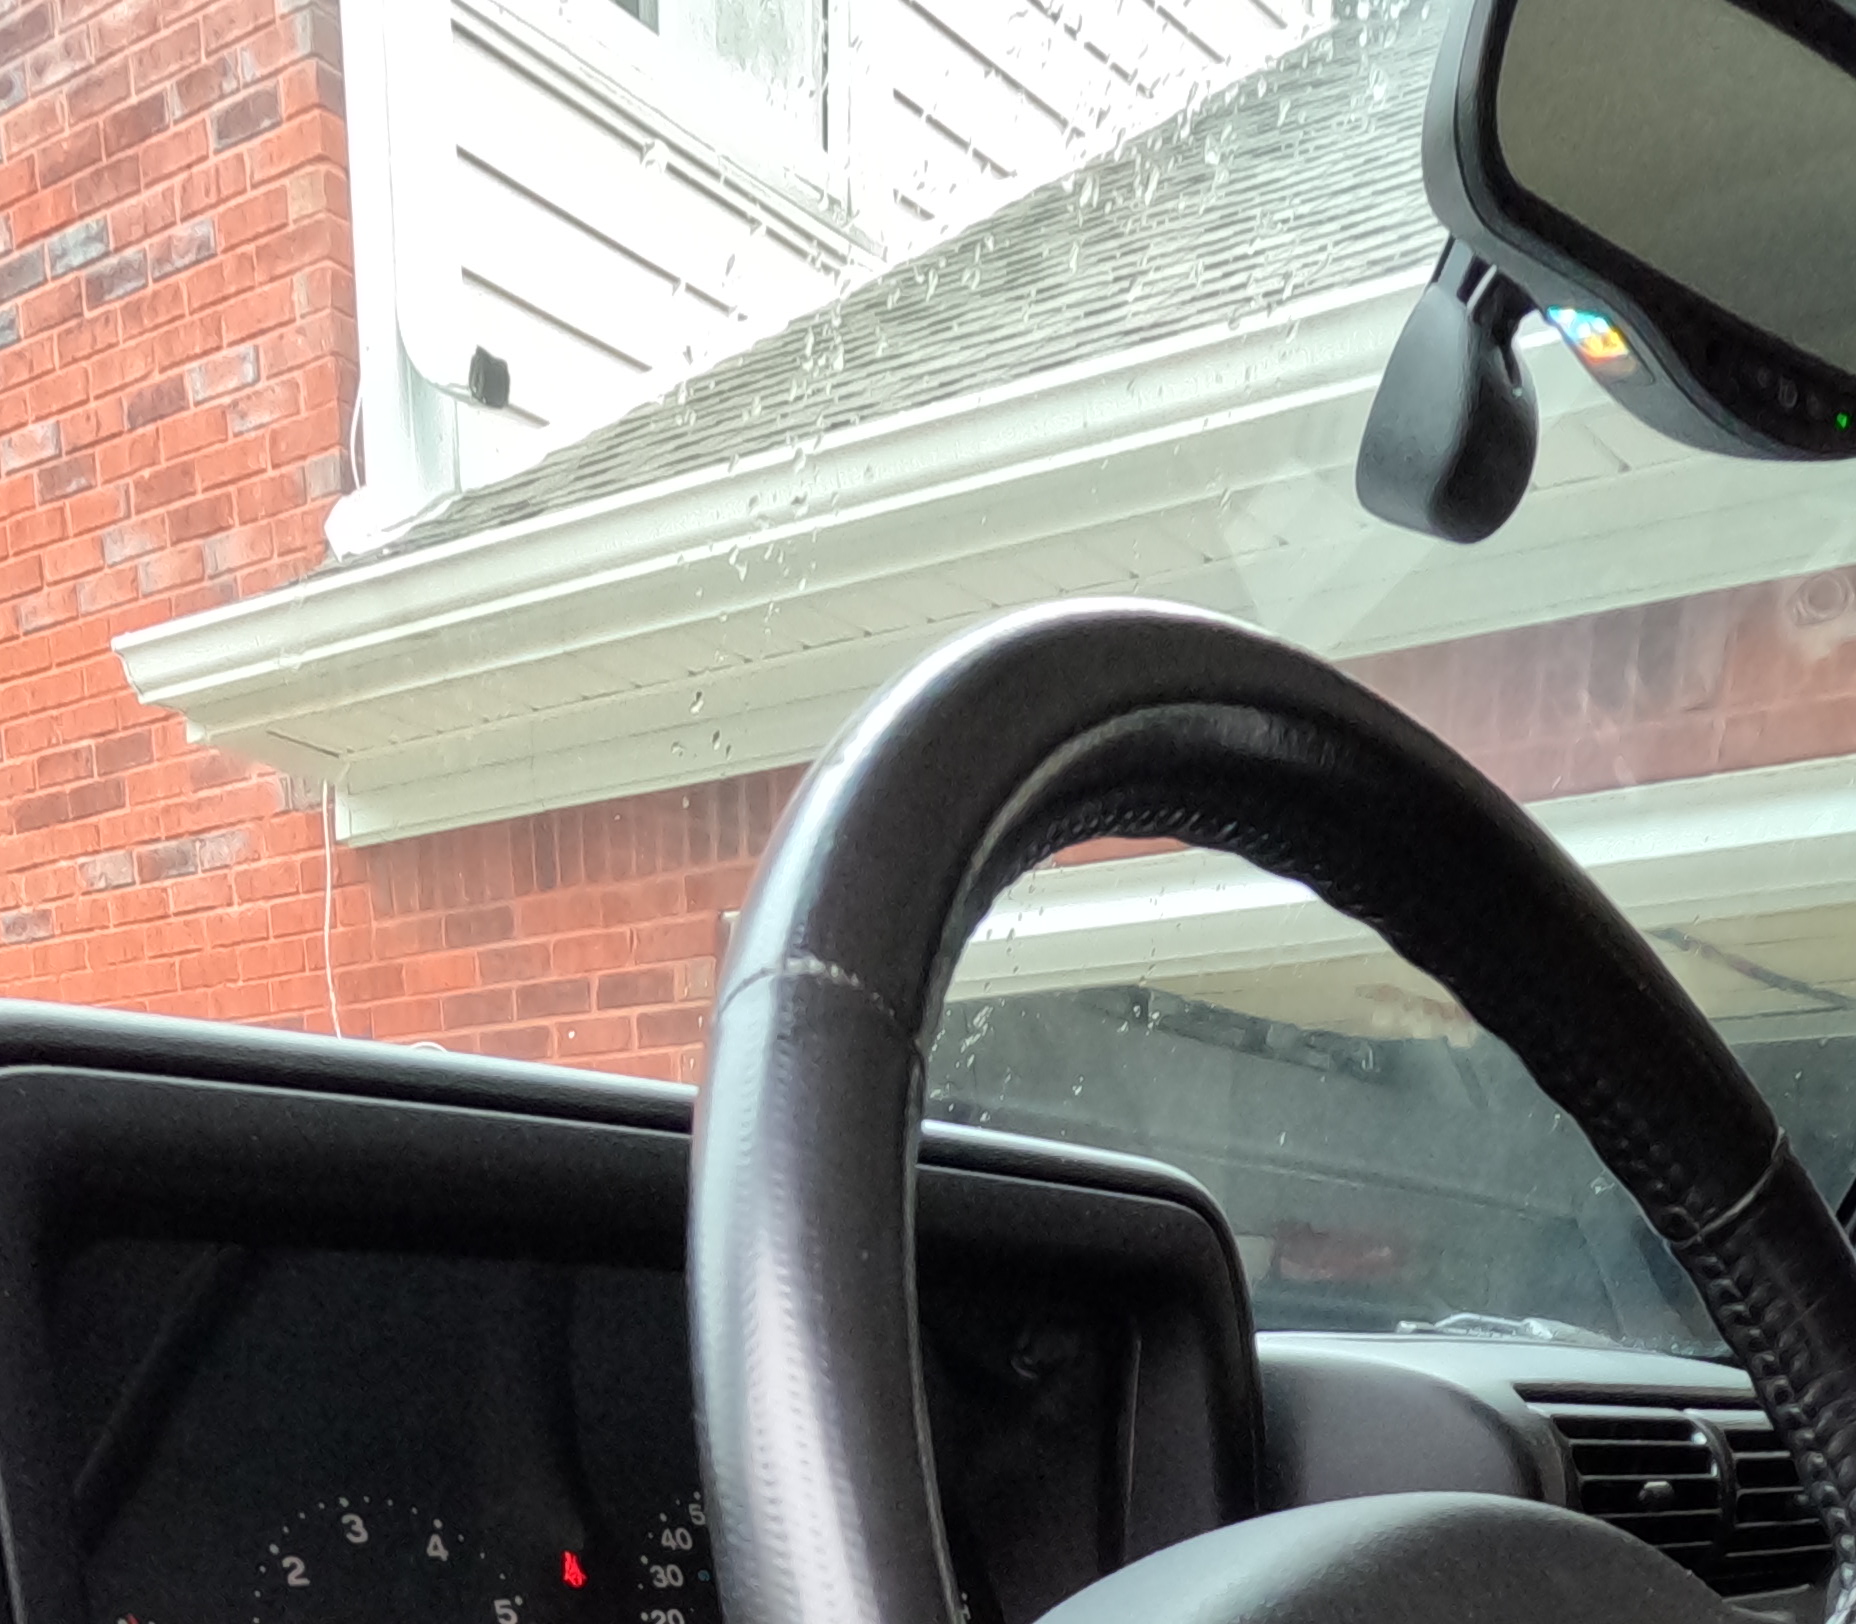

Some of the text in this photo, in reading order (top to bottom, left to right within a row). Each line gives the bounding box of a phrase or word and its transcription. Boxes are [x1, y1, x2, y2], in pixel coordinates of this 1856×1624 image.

[342, 1513, 369, 1544] 3
[661, 1527, 693, 1550] 40
[426, 1534, 449, 1562] 4
[282, 1556, 311, 1587] 2
[650, 1564, 684, 1588] 30
